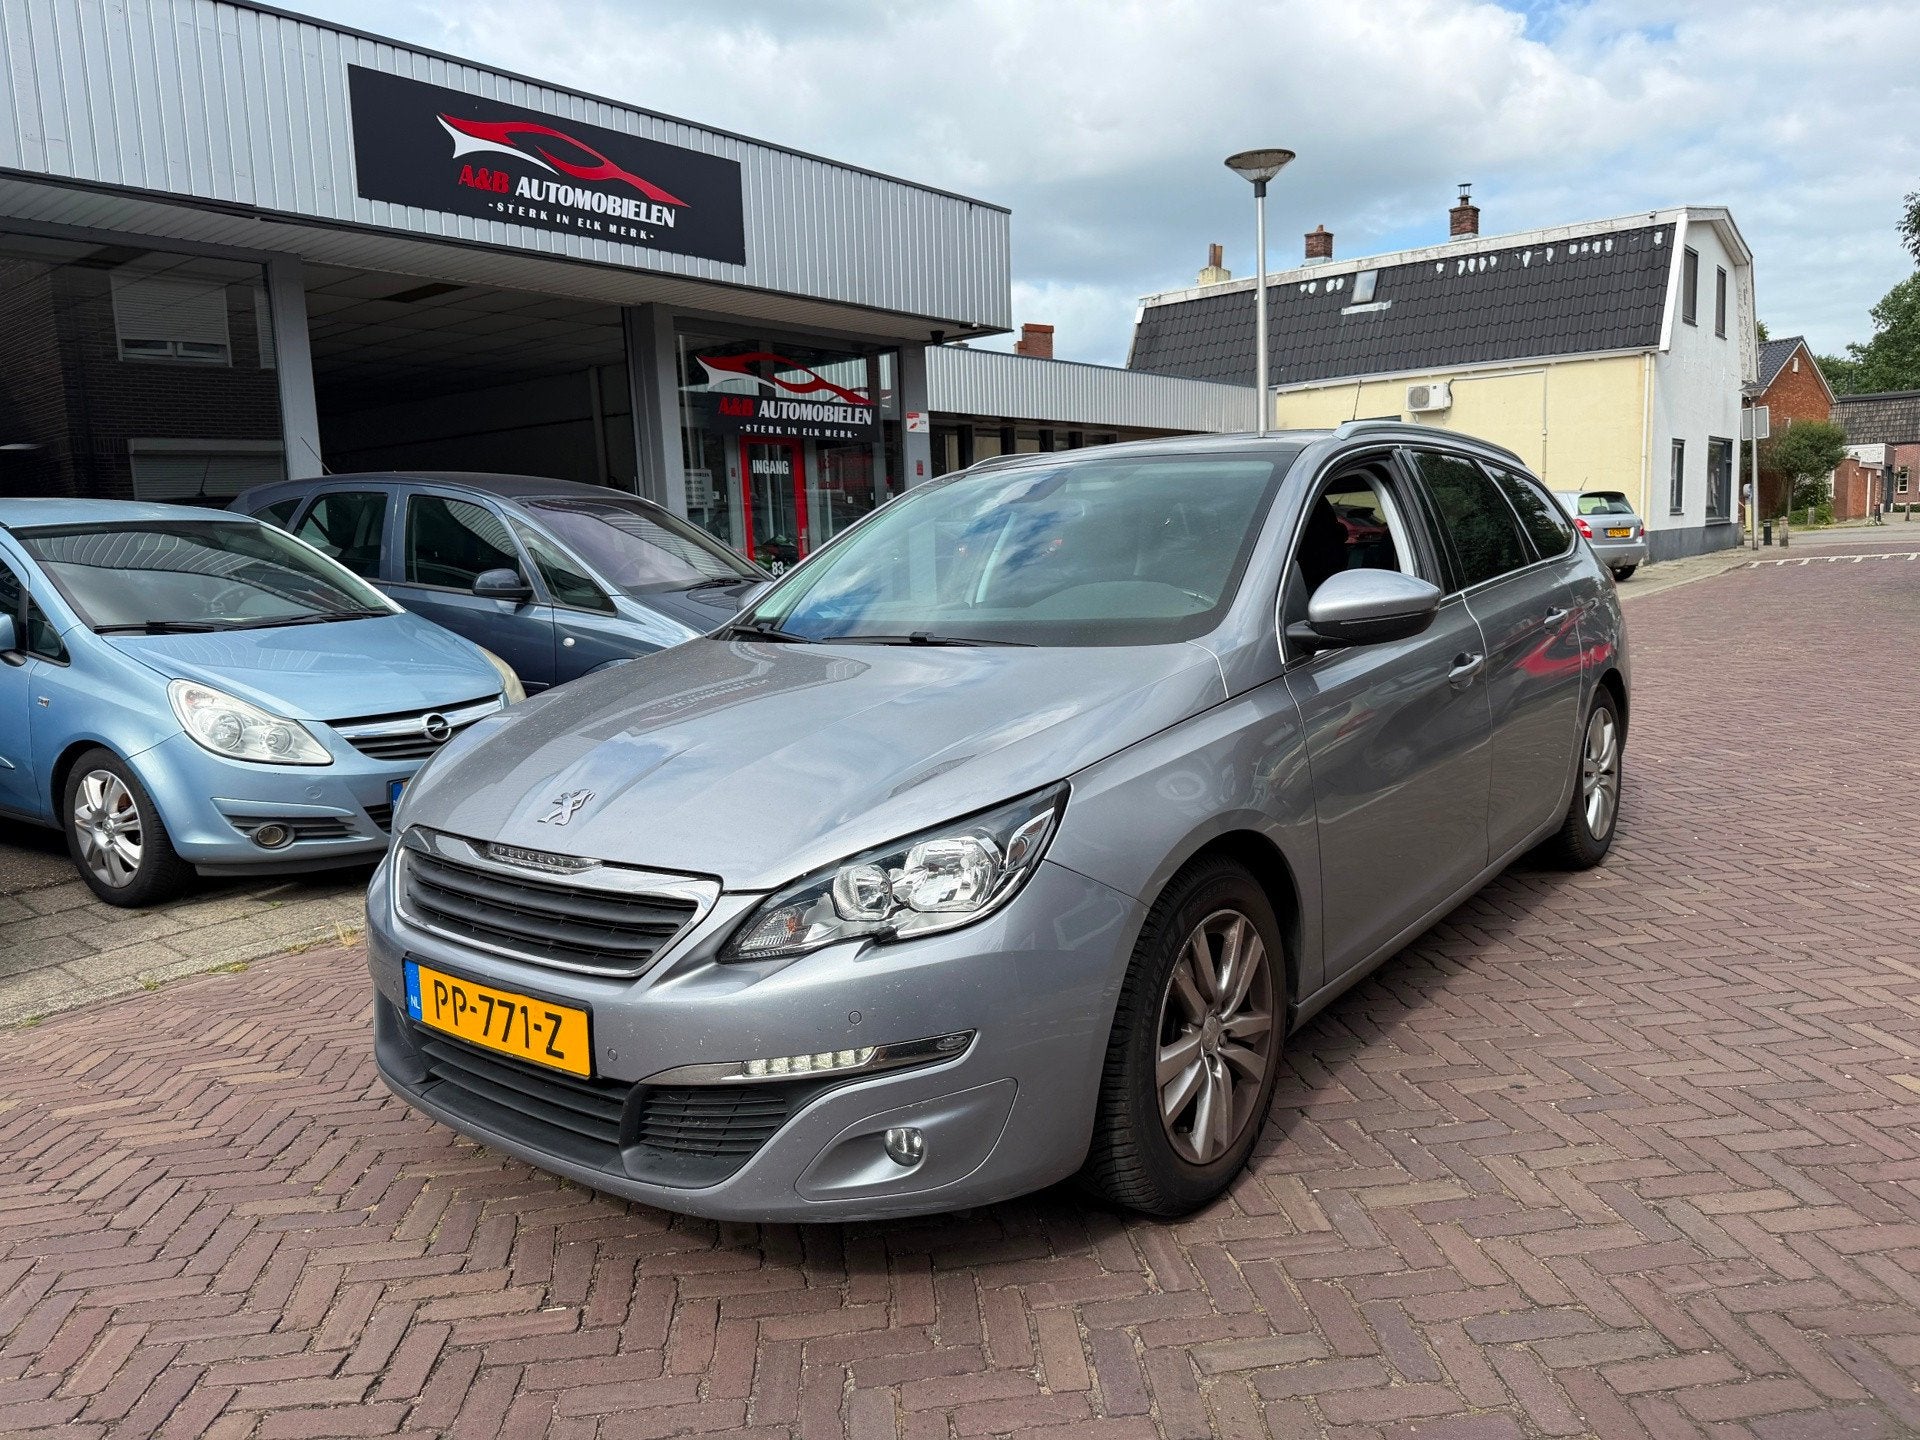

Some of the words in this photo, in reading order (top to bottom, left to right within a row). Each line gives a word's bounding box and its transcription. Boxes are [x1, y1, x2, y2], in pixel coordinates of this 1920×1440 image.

[458, 164, 510, 194] A&B
[515, 176, 676, 228] AUTOMOBIELEN
[556, 213, 570, 225] IN
[577, 217, 602, 231] ELK
[718, 396, 755, 417] A&B
[758, 400, 873, 426] AUTOMOBIELEN
[787, 426, 797, 435] IN
[802, 427, 820, 437] ELK
[752, 459, 789, 475] INGANG
[771, 561, 784, 576] 83
[499, 846, 566, 867] PEUGEOT
[410, 994, 421, 1010] NL
[433, 979, 565, 1060] PP-771-Z
